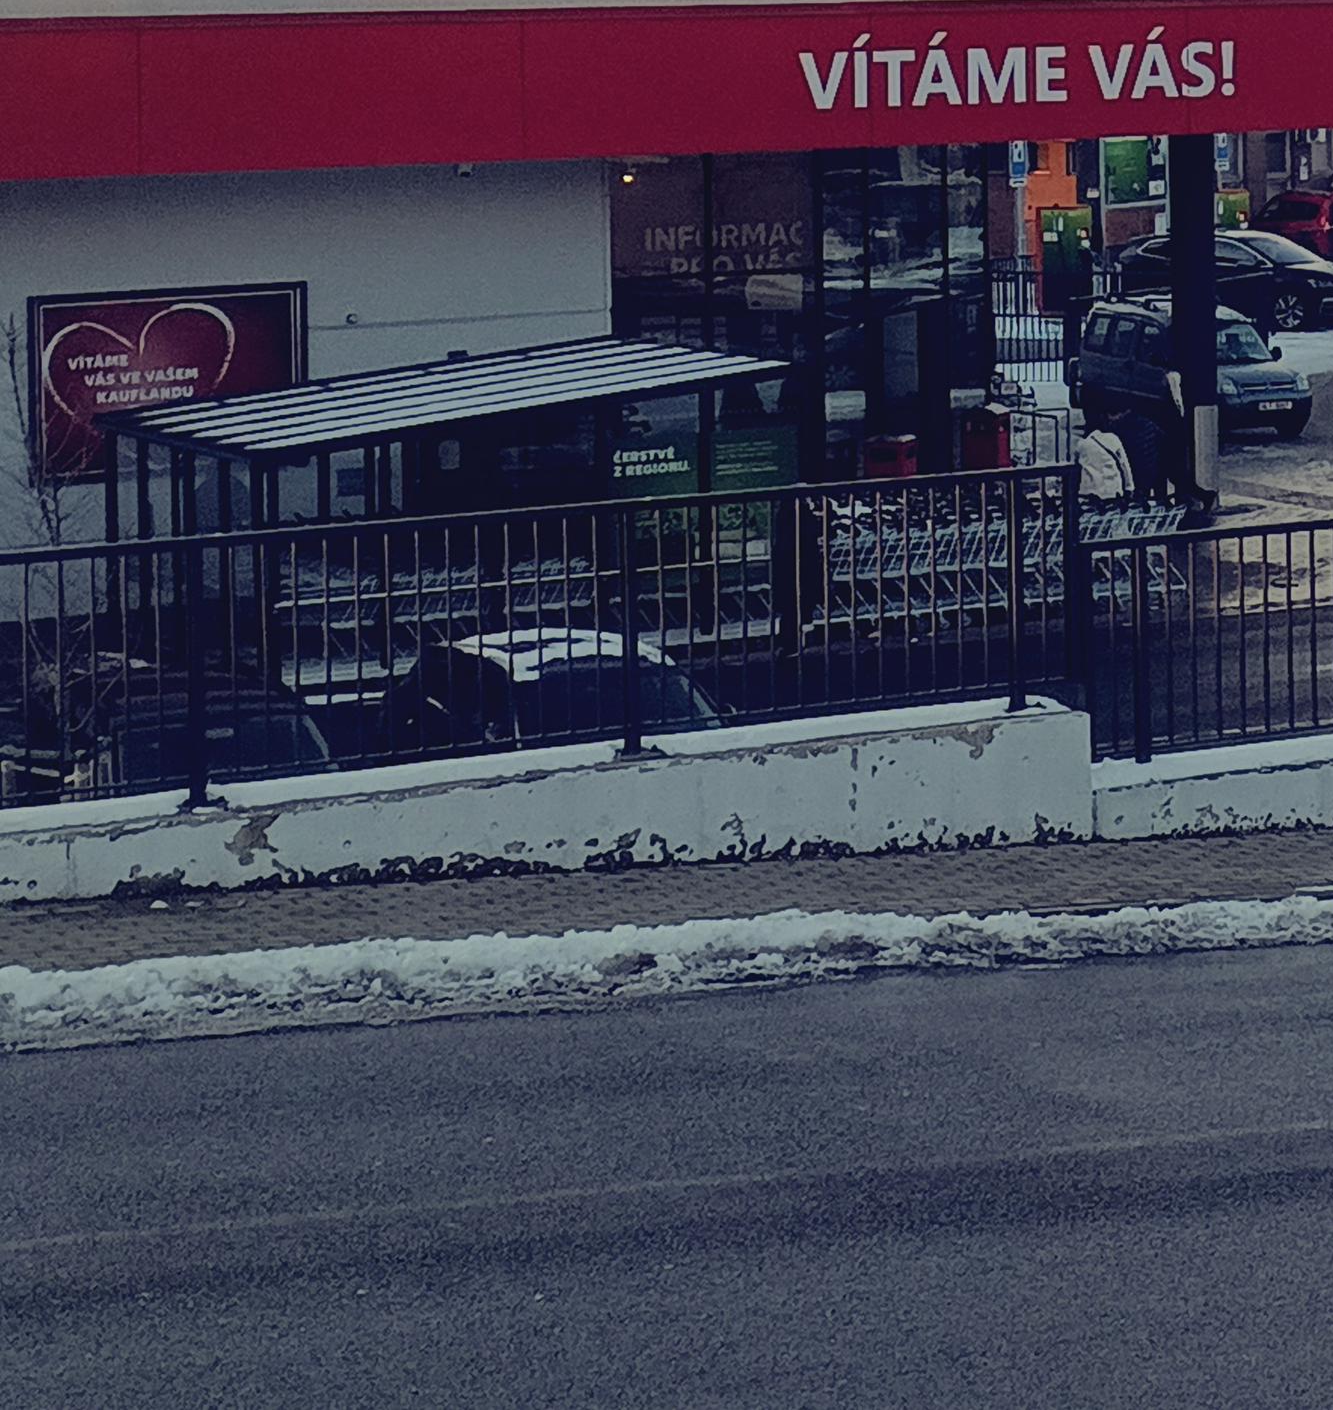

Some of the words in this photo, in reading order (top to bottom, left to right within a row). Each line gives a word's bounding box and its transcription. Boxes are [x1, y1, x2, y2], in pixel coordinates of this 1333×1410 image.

[799, 31, 1069, 111] VÍTÁME
[1087, 25, 1237, 101] VÁS!
[67, 353, 129, 371] VÍTÁME
[84, 371, 116, 387] VÁS
[119, 370, 141, 385] VE
[144, 366, 199, 383] VAŠEM
[95, 385, 194, 405] KAUFLANDU
